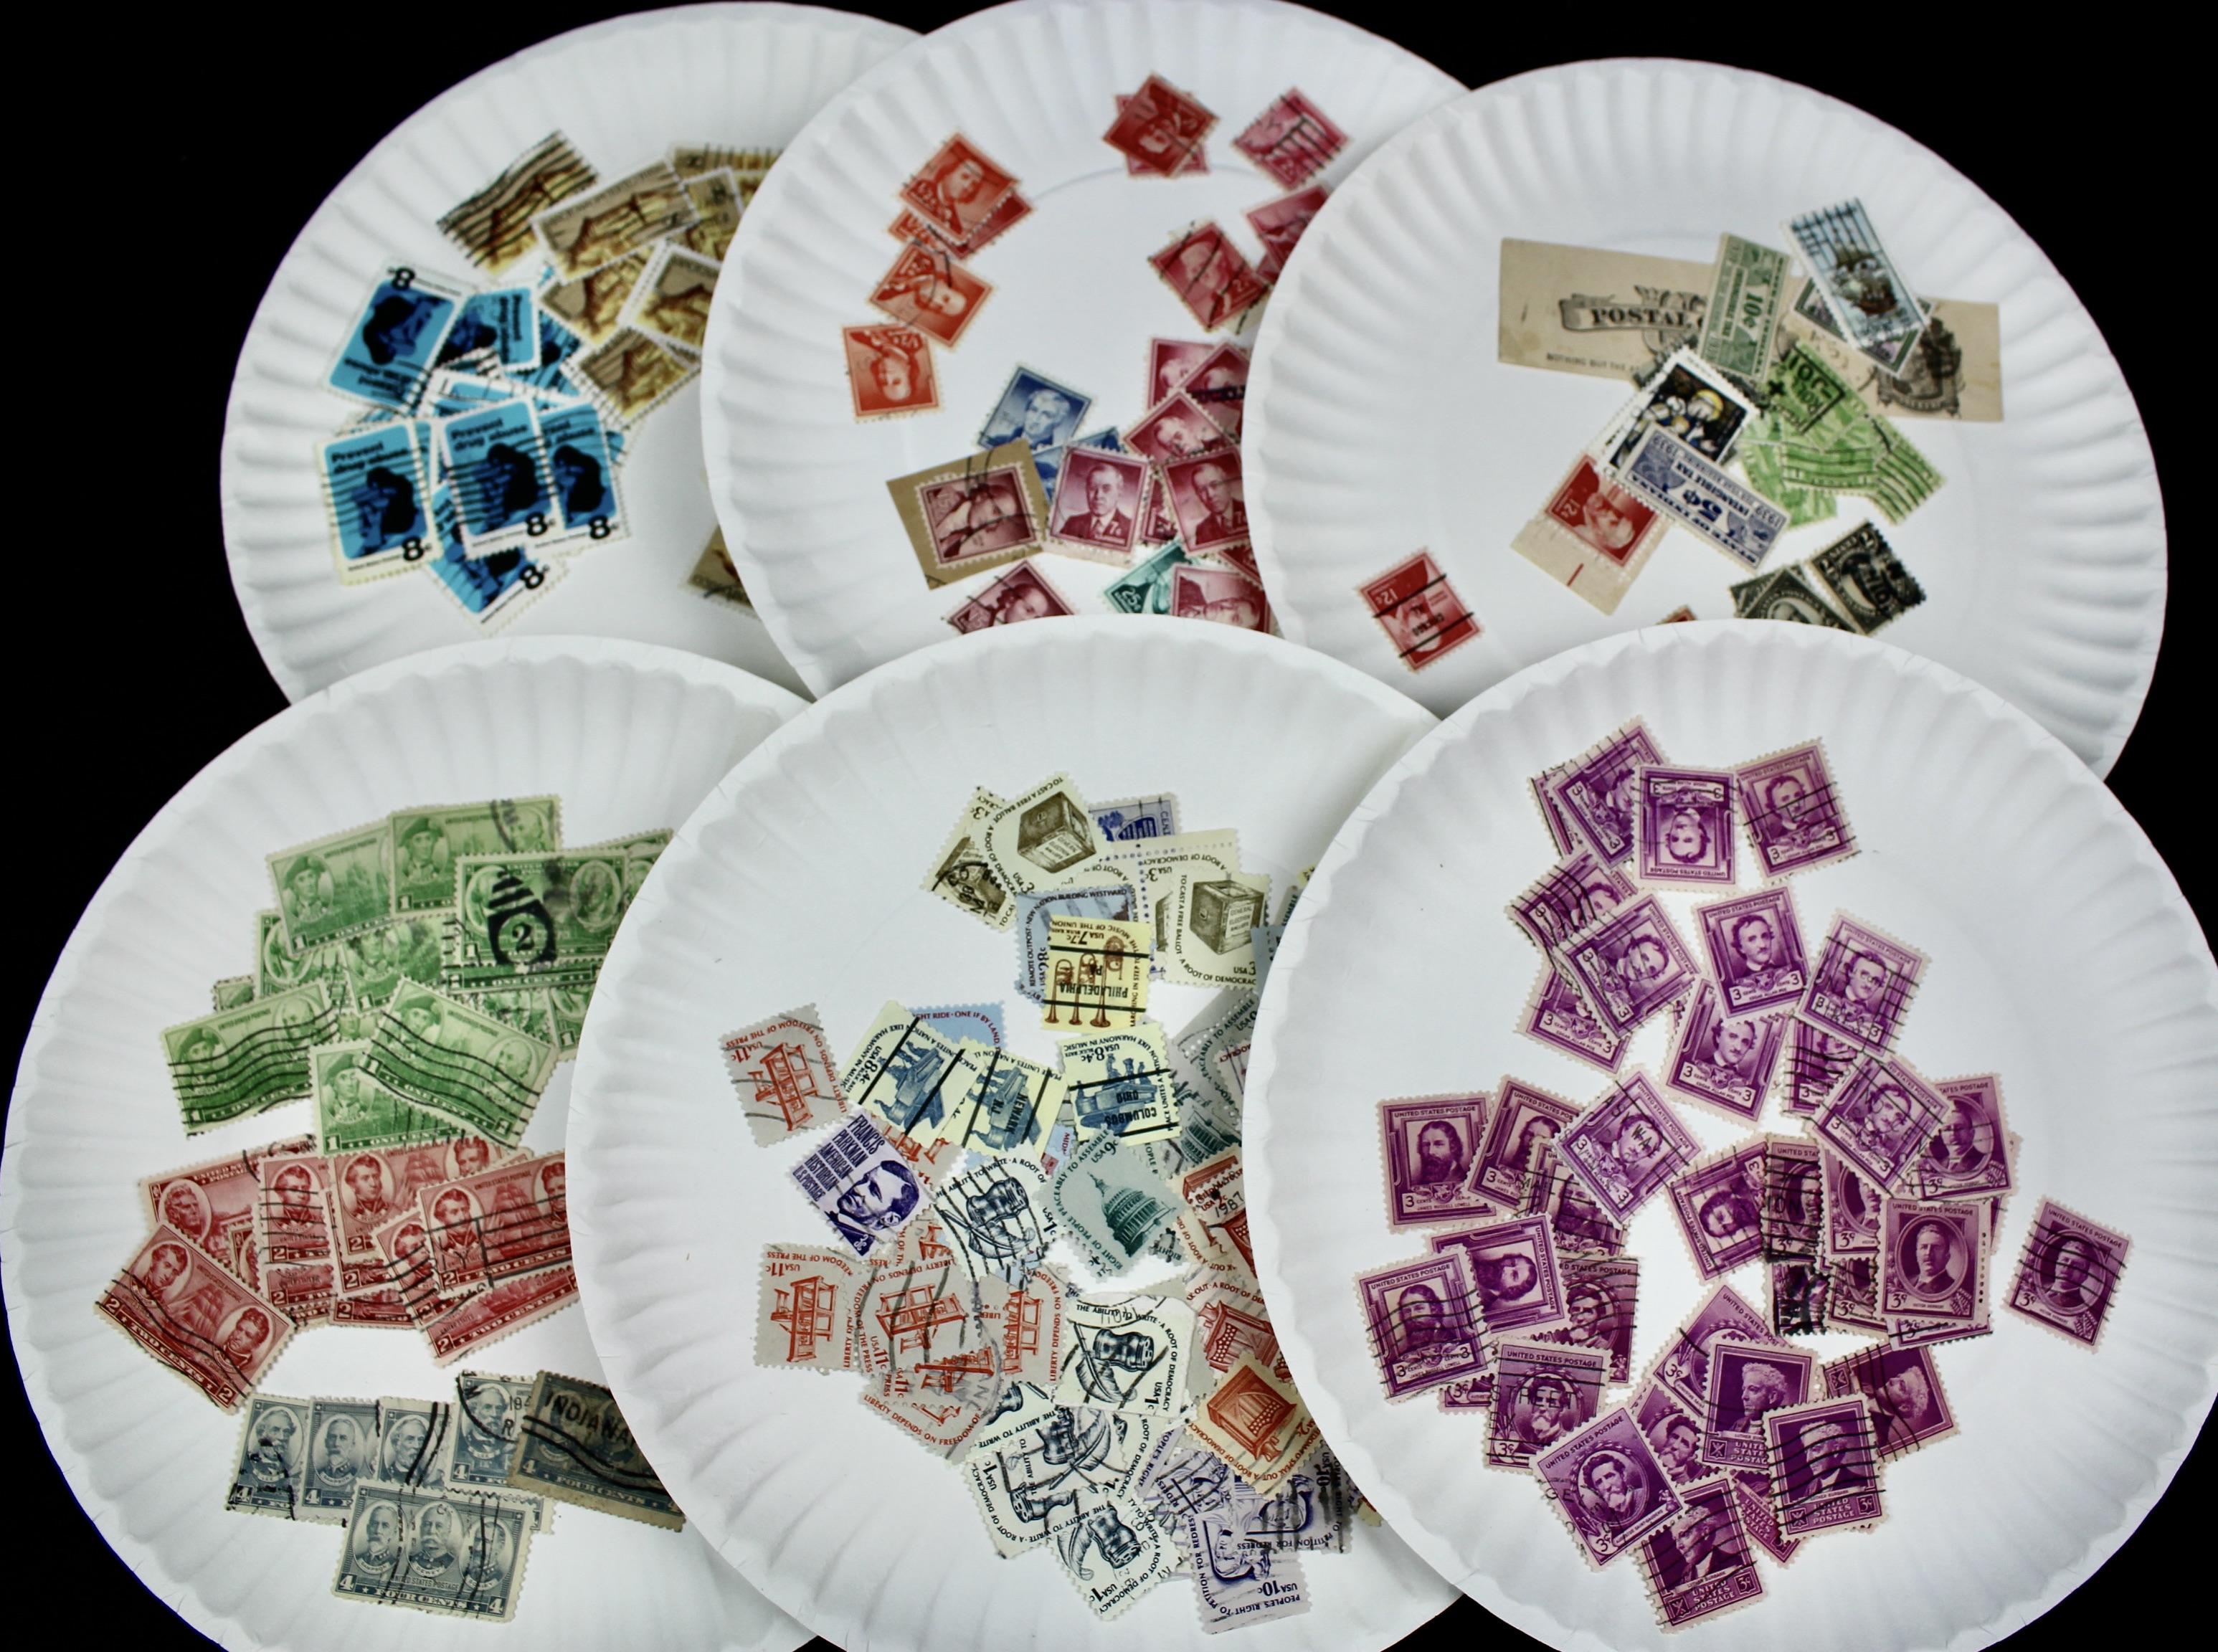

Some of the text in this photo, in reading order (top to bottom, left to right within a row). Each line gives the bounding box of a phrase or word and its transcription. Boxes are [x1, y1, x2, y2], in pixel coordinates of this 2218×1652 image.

[1591, 308, 1692, 327] POSTAL
[1737, 291, 1768, 331] 10¢
[1546, 352, 1627, 371] NOTHING BUT THE
[450, 418, 504, 441] Prevent
[453, 424, 529, 452] drug abuse
[331, 440, 384, 463] Prevent
[1648, 432, 1680, 459] 1939
[1674, 460, 1754, 518] INTANGIBLE TAX
[1752, 503, 1781, 527] 1939
[511, 919, 534, 950] 2
[1233, 965, 1247, 974] USA
[491, 975, 560, 987] ONE CENT
[1059, 981, 1129, 998] PHILADELPHIA
[1542, 1012, 1555, 1027] 3
[868, 1044, 883, 1060] USA
[1104, 1043, 1120, 1053] USA
[1896, 1071, 1938, 1111] STATES POSTAGE
[1959, 1081, 1989, 1091] POSTAGE
[1115, 1089, 1139, 1103] OHIO
[1512, 1091, 1560, 1114] UNITED STATES
[1003, 1092, 1028, 1136] NEWARK
[1104, 1106, 1157, 1126] COLUMBUS
[1444, 1104, 1475, 1114] POSTAGE
[328, 1136, 338, 1150] 1
[845, 1114, 886, 1155] FRANCIS
[831, 1129, 868, 1168] PARKMAN
[1091, 1148, 1106, 1163] USA
[817, 1141, 853, 1179] AMERICAN
[803, 1154, 839, 1192] HISTORIAN
[1484, 1165, 1498, 1182] 3
[1053, 1129, 1123, 1270] RIGHT OF PEOPLE PEACEABLY TO ASSEMBLE
[1213, 1190, 1244, 1218] 1987
[1892, 1202, 1973, 1215] UNITED POSTAGE
[351, 1236, 363, 1250] 2
[273, 1247, 284, 1259] 2
[767, 1251, 790, 1260] PRESS
[791, 1253, 807, 1261] THE
[443, 1249, 568, 1285] 2 TWO CENTS
[785, 1263, 800, 1272] USA
[1370, 1263, 1451, 1289] UNITED STATES POSTAGE
[1535, 1225, 1556, 1309] UNITED STATES POSTAGE
[1568, 1263, 1632, 1276] STATES POSTAGE
[272, 1291, 284, 1304] 2
[436, 1297, 556, 1352] 2 TWO CENTS
[103, 1296, 234, 1405] 2 TWO CENTS 2
[870, 1334, 881, 1352] USA
[1395, 1362, 1407, 1377] 3
[1153, 1380, 1162, 1399] USA
[1489, 1383, 1575, 1410] STREET
[501, 1419, 514, 1436] R
[863, 1394, 982, 1454] LIBERTY DEPENDS ON FREEDOM OF
[978, 1409, 1056, 1447] THE ABILITY TO WRITE
[453, 1462, 468, 1479] 4
[521, 1458, 646, 1505] 4 FOUR CENTS
[304, 1488, 320, 1504] 4
[1741, 1496, 1777, 1528] UNITED
[1811, 1509, 1855, 1524] POSTAGE
[1812, 1502, 1851, 1516] STATES
[1236, 1532, 1333, 1551] PETITION FOR REDRESS
[359, 1557, 388, 1575] SAMPSON
[414, 1564, 442, 1579] DEWEY
[412, 1577, 432, 1587] STATES
[431, 1580, 458, 1592] POSTAGE
[1195, 1552, 1301, 1615] PEOPLE'S RIGHT TO PETITION FOR
[1279, 1582, 1297, 1592] USA
[1689, 1577, 1729, 1596] UNITED
[338, 1573, 503, 1614] 4 FOUR CENTS 4
[1689, 1584, 1733, 1603] STATES
[1690, 1590, 1737, 1610] POSTAGE
